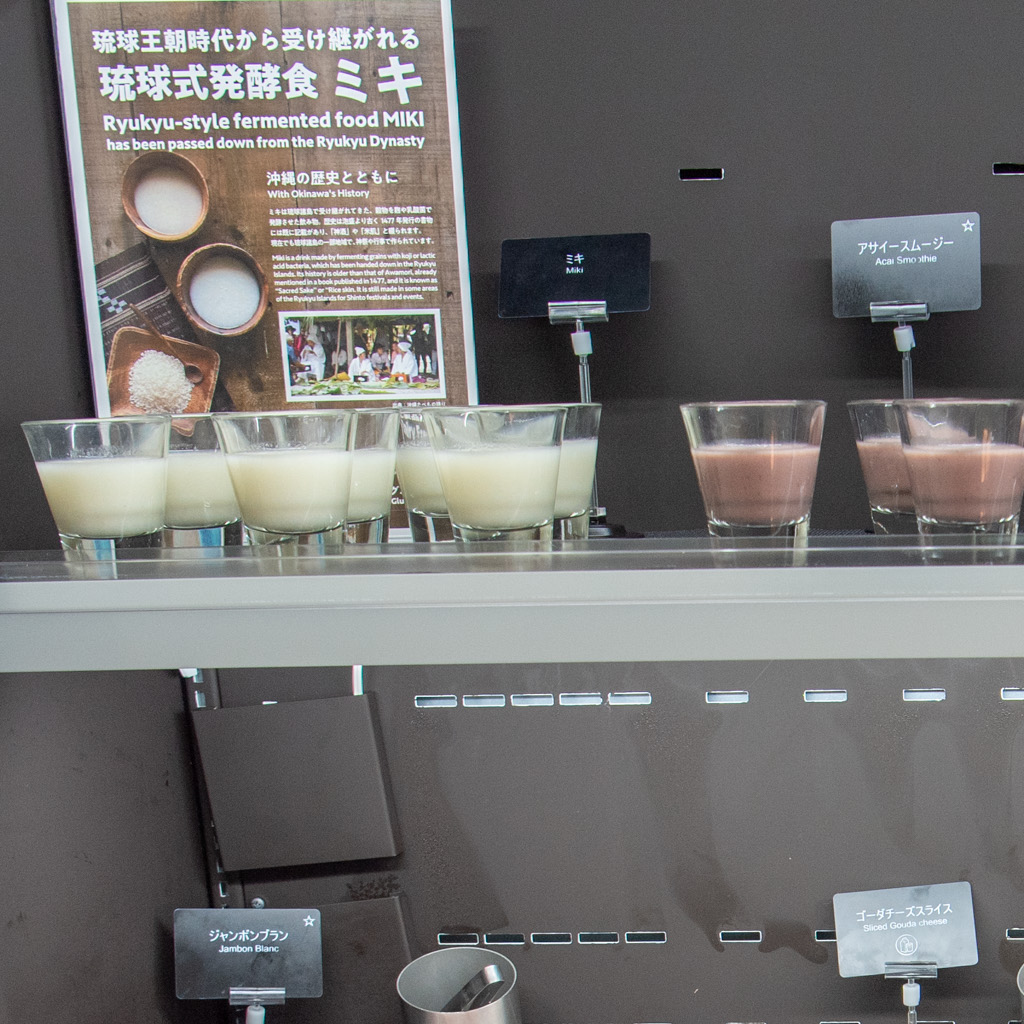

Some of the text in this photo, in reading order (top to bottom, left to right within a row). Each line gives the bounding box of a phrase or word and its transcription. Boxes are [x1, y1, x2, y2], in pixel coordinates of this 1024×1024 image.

[92, 28, 419, 54] 琉球王朝時代から受け継がれる
[98, 55, 423, 105] 琉球式発酵食 ミキ
[103, 110, 425, 134] Ryukyu-style fermented food MIKI
[107, 134, 425, 153] has been passed down from the Ryukyu Dynasty
[266, 170, 399, 186] 沖縄の歴史とともに
[267, 189, 370, 199] With Okinawa's History
[858, 237, 954, 255] アサイースムージー
[566, 253, 584, 264] ミキ
[566, 266, 584, 274] Miki
[856, 903, 953, 922] ゴーダチーズスライス
[863, 918, 948, 932] Sliced Gouda cheese
[208, 929, 289, 942] ジャンボンブラン
[218, 945, 279, 953] Jambon Blanc
